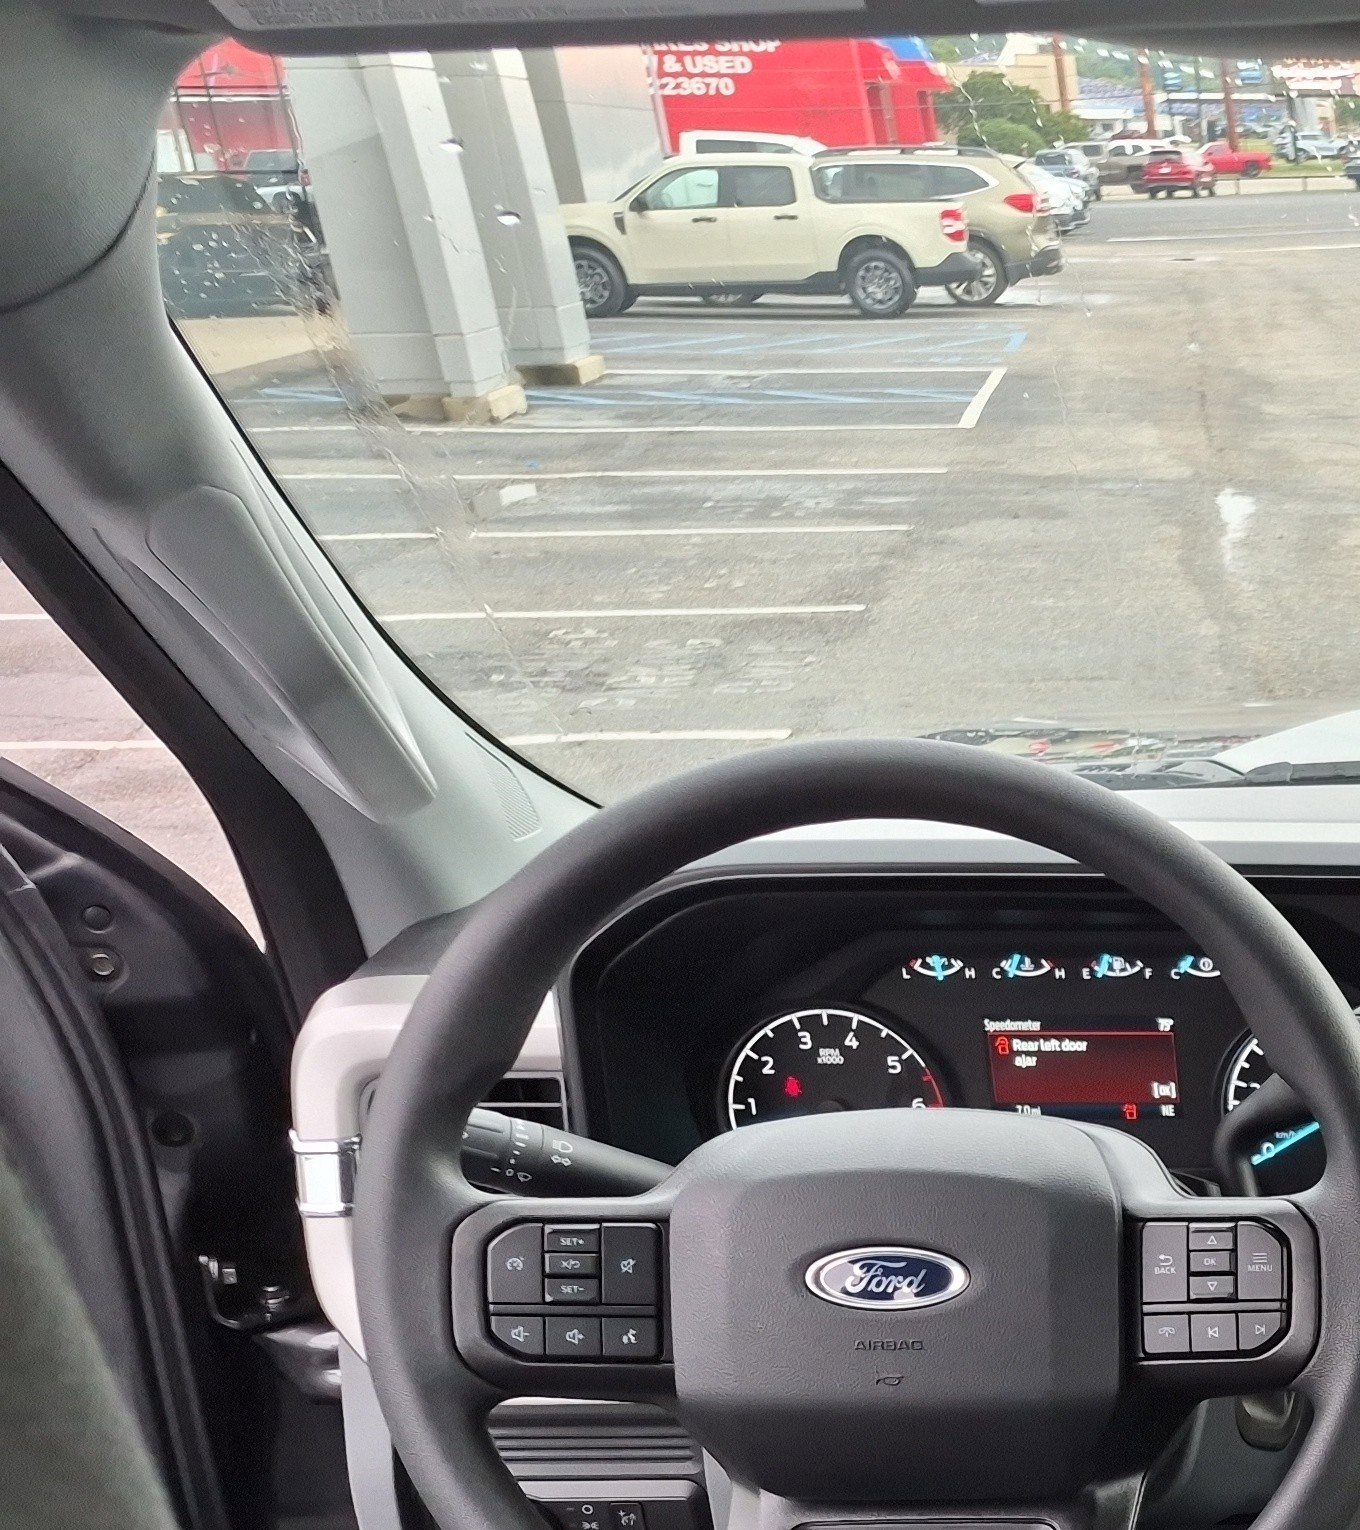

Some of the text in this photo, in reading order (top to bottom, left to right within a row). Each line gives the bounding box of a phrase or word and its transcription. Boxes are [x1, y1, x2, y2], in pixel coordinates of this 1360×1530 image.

[683, 54, 753, 74] USED
[902, 967, 911, 979] L
[965, 967, 976, 979] H
[992, 967, 1001, 979] C
[1055, 967, 1066, 979] H
[1083, 967, 1091, 979] E
[1145, 967, 1153, 979] F
[1171, 969, 1181, 980] C
[984, 1018, 1041, 1032] Speedometer
[798, 1031, 812, 1050] 3
[844, 1031, 859, 1049] 4
[1013, 1038, 1087, 1051] Rear left door
[819, 1048, 839, 1057] RPM
[761, 1056, 775, 1074] 2
[887, 1056, 901, 1073] 5
[1014, 1054, 1037, 1068] ajar
[748, 1097, 756, 1115] 1
[1203, 1257, 1216, 1265] OK
[1247, 1264, 1273, 1272] MENU
[845, 1259, 928, 1294] Ford
[855, 1340, 924, 1351] AIRBAG
